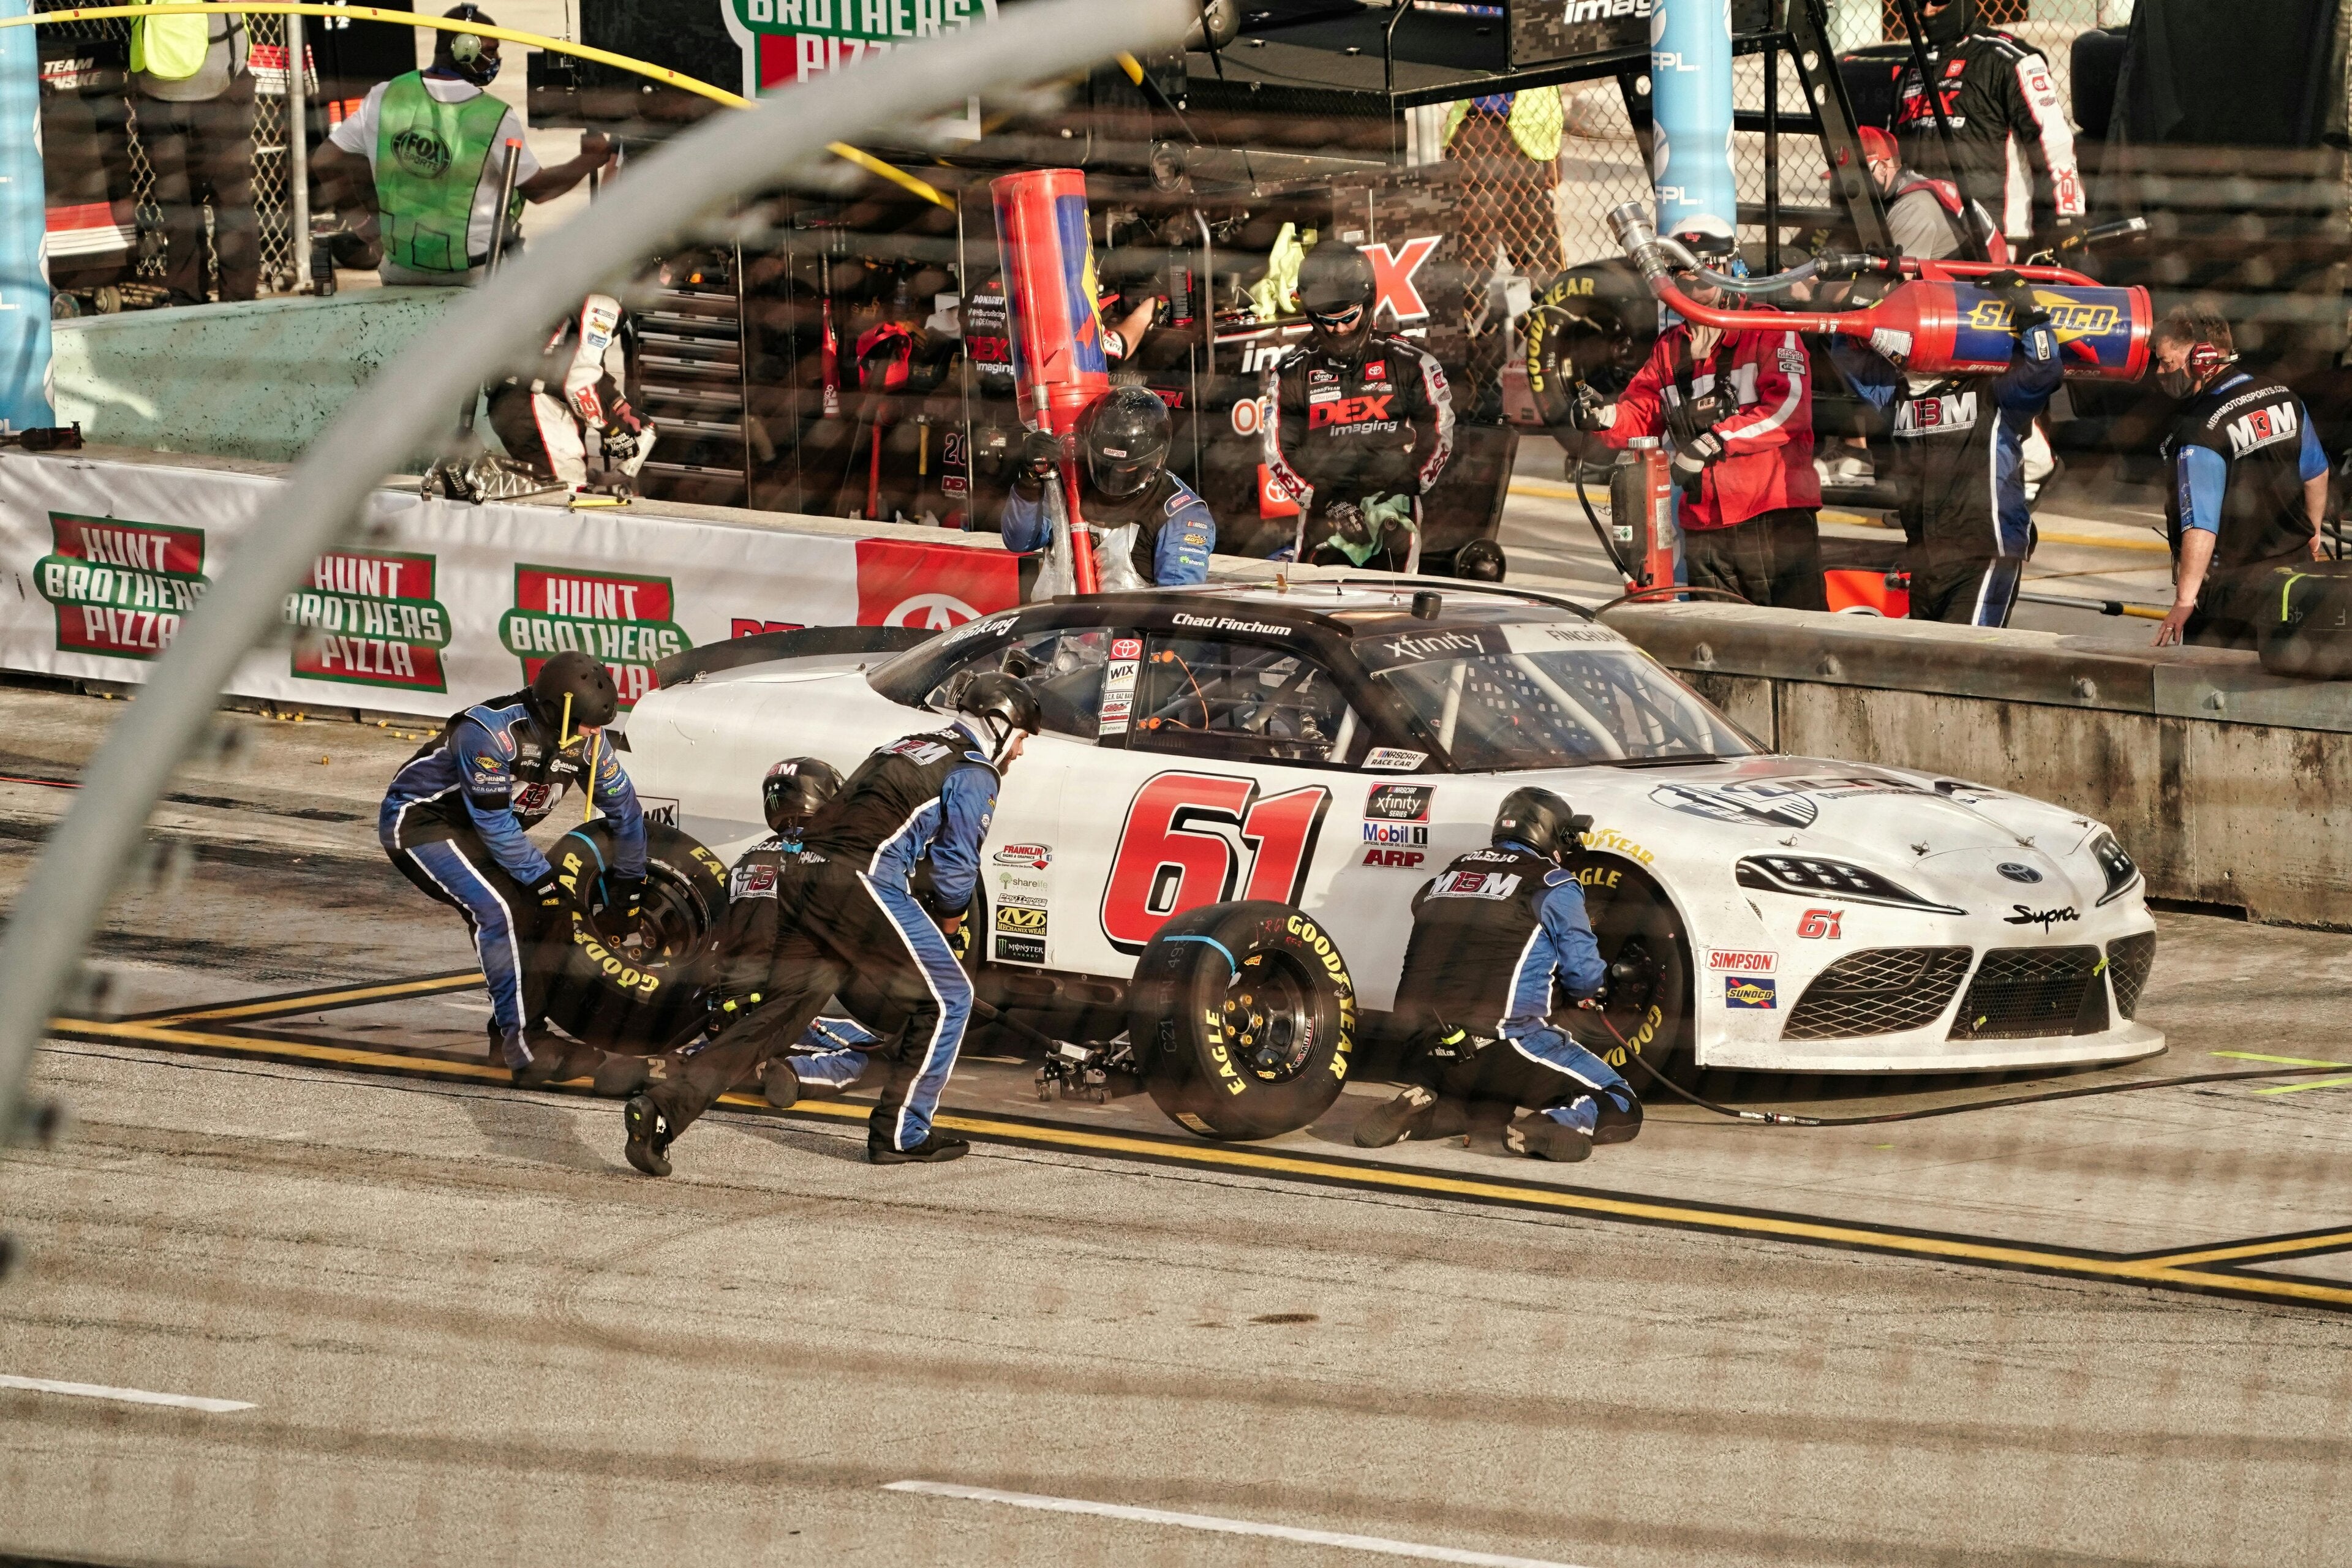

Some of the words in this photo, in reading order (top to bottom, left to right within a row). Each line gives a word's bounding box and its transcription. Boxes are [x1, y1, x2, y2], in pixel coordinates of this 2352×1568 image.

[44, 58, 94, 74] TEAM
[796, 32, 916, 83] PIZ
[46, 72, 102, 90] NSKE
[405, 133, 441, 163] FOX
[404, 151, 441, 172] SPORTS
[1976, 303, 2113, 331] SUOCO
[966, 336, 1009, 362] DEX
[1309, 394, 1394, 431] DEX
[2206, 385, 2290, 430] MBMMOTORSPORTS.COM
[1330, 420, 1398, 437] imaging
[80, 527, 171, 572] HUNT
[45, 564, 206, 611] BROTHERS
[314, 555, 403, 598] HUNT
[546, 578, 638, 620] HUNT
[83, 605, 180, 648] PIZZA
[283, 593, 443, 641] BROTHERS
[1172, 613, 1219, 628] Chad
[1220, 618, 1291, 636] Finchum
[510, 617, 681, 660] BROTHERS
[1384, 631, 1485, 660] xfinity
[1546, 630, 1624, 643] FINCHUM
[320, 635, 415, 677] PIZZA
[1110, 664, 1135, 680] WIX
[476, 758, 501, 767] SUNOCO
[1384, 750, 1419, 761] NASCAR
[1376, 794, 1421, 814] xfinity
[1363, 823, 1409, 843] Mobil
[1003, 845, 1043, 856] FRANKLIN
[1101, 770, 1332, 956] 61
[1363, 850, 1425, 867] ARP
[1012, 878, 1048, 888] sharelife
[997, 922, 1028, 933] MECHANIX
[1796, 909, 1845, 940] 61
[2003, 905, 2081, 935] Supra
[1008, 943, 1044, 954] MONSTER
[1710, 952, 1773, 970] SIMPSON
[1729, 989, 1773, 998] SUNOCO
[1205, 1009, 1247, 1095] EAGLE
